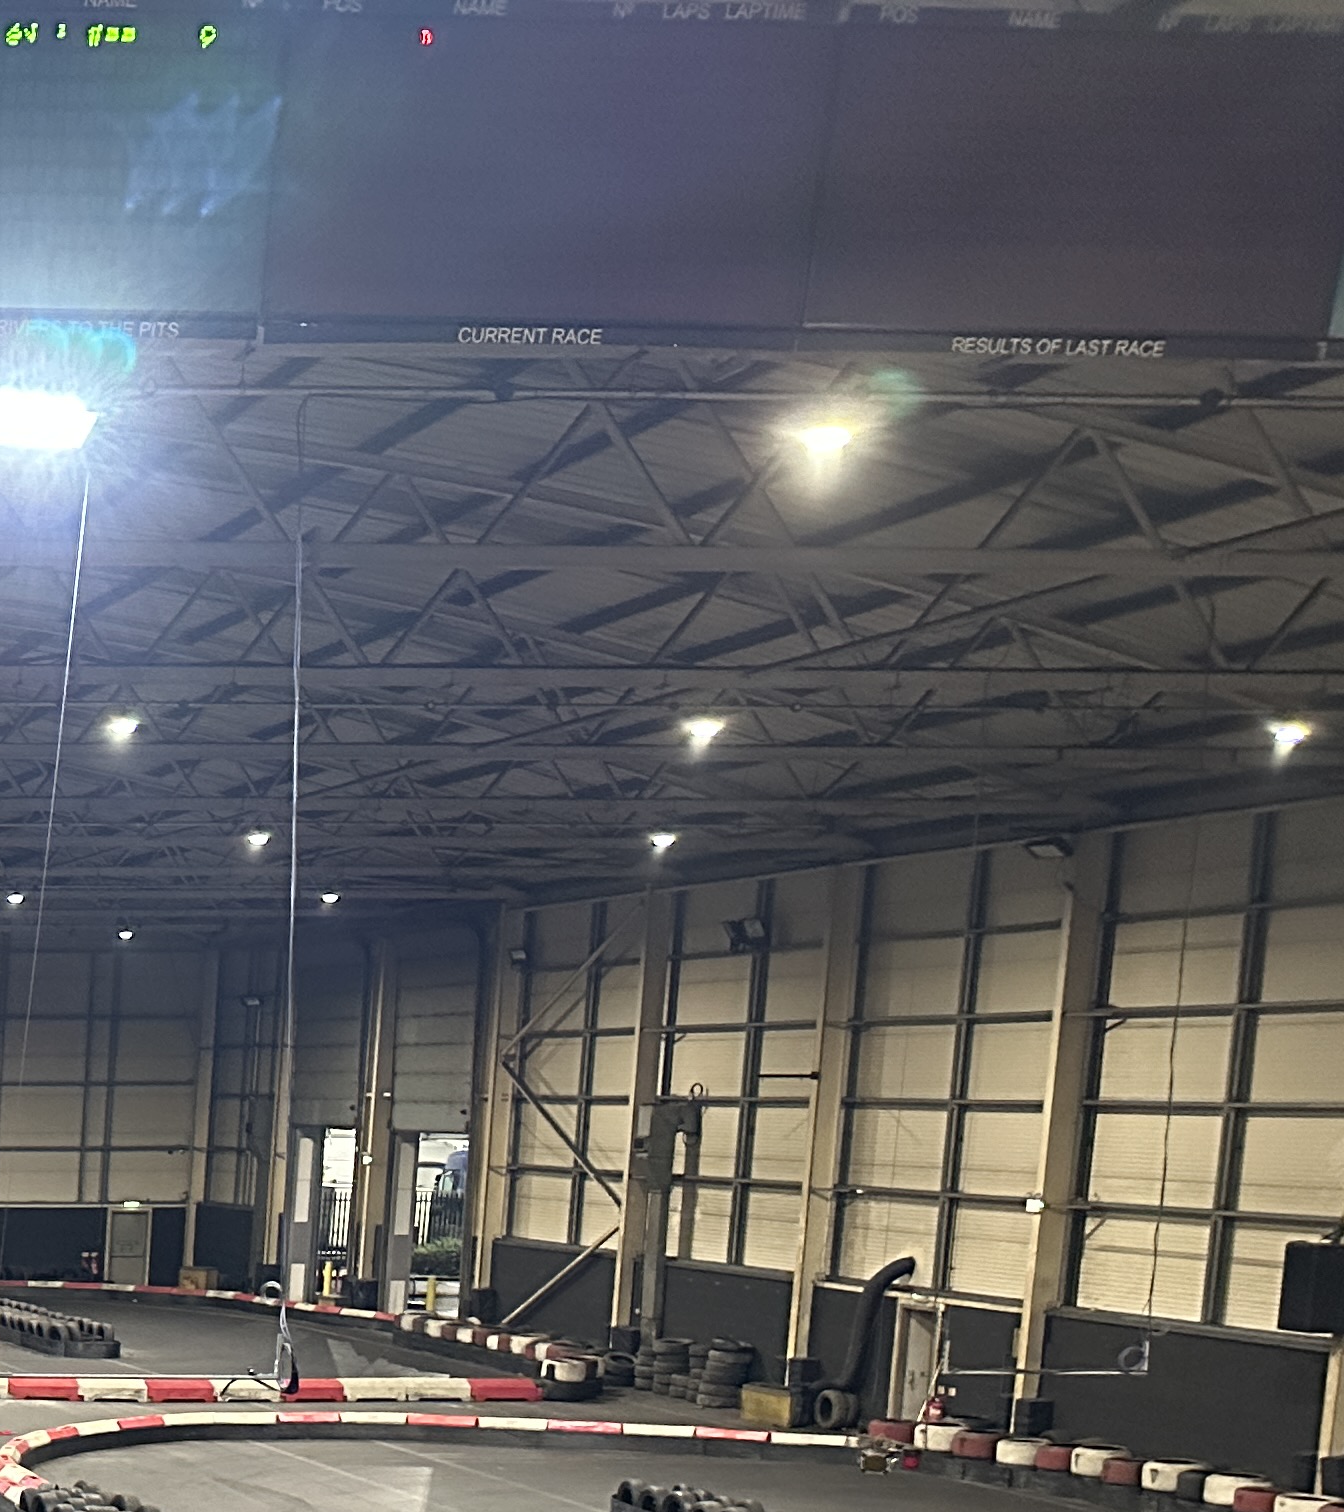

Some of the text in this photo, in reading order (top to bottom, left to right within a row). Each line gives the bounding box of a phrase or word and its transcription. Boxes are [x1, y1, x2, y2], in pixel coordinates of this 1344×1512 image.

[662, 3, 711, 20] LAPS
[723, 3, 807, 21] LAPTIME
[139, 321, 180, 337] PITS
[458, 326, 603, 345] CURRENT RACE
[951, 336, 1167, 357] RESULTS OF LAST RACE
